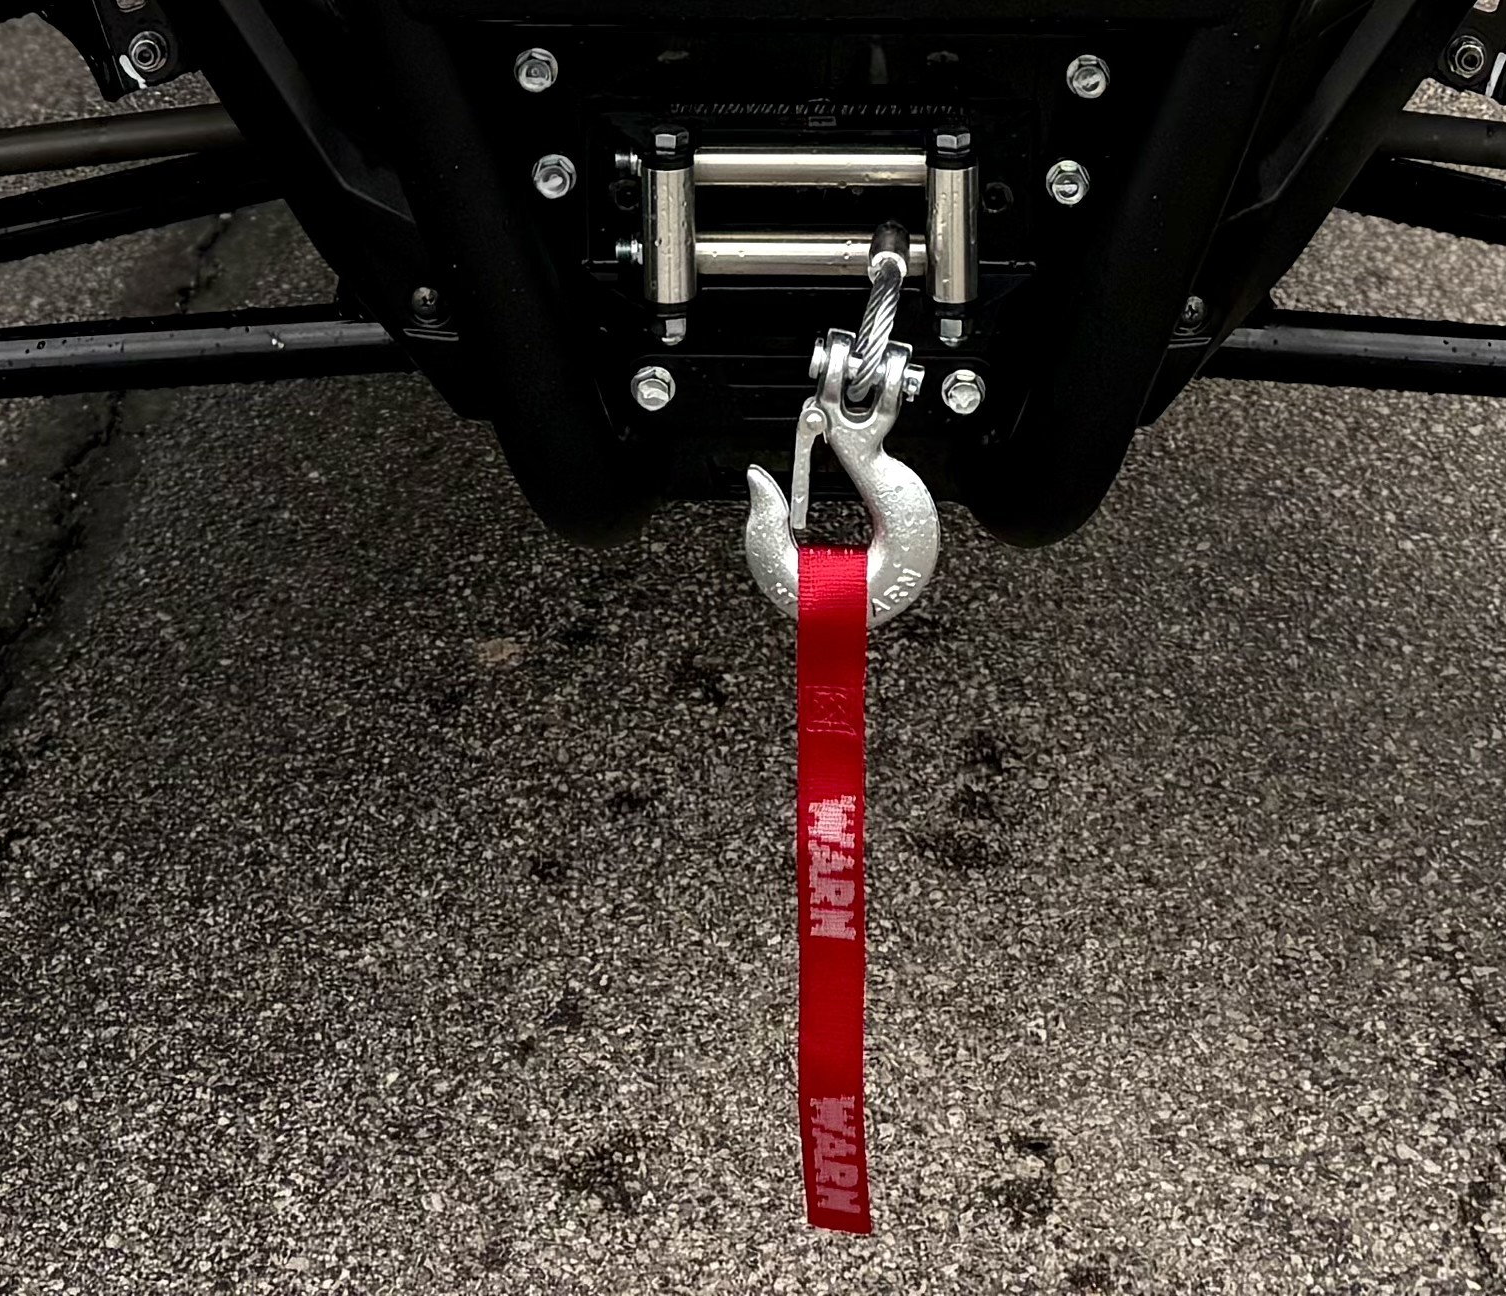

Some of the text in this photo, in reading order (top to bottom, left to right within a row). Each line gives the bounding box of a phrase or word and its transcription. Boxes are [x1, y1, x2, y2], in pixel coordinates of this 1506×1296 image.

[871, 567, 923, 618] ARN
[808, 795, 857, 941] WARN
[809, 1093, 862, 1214] WARN
